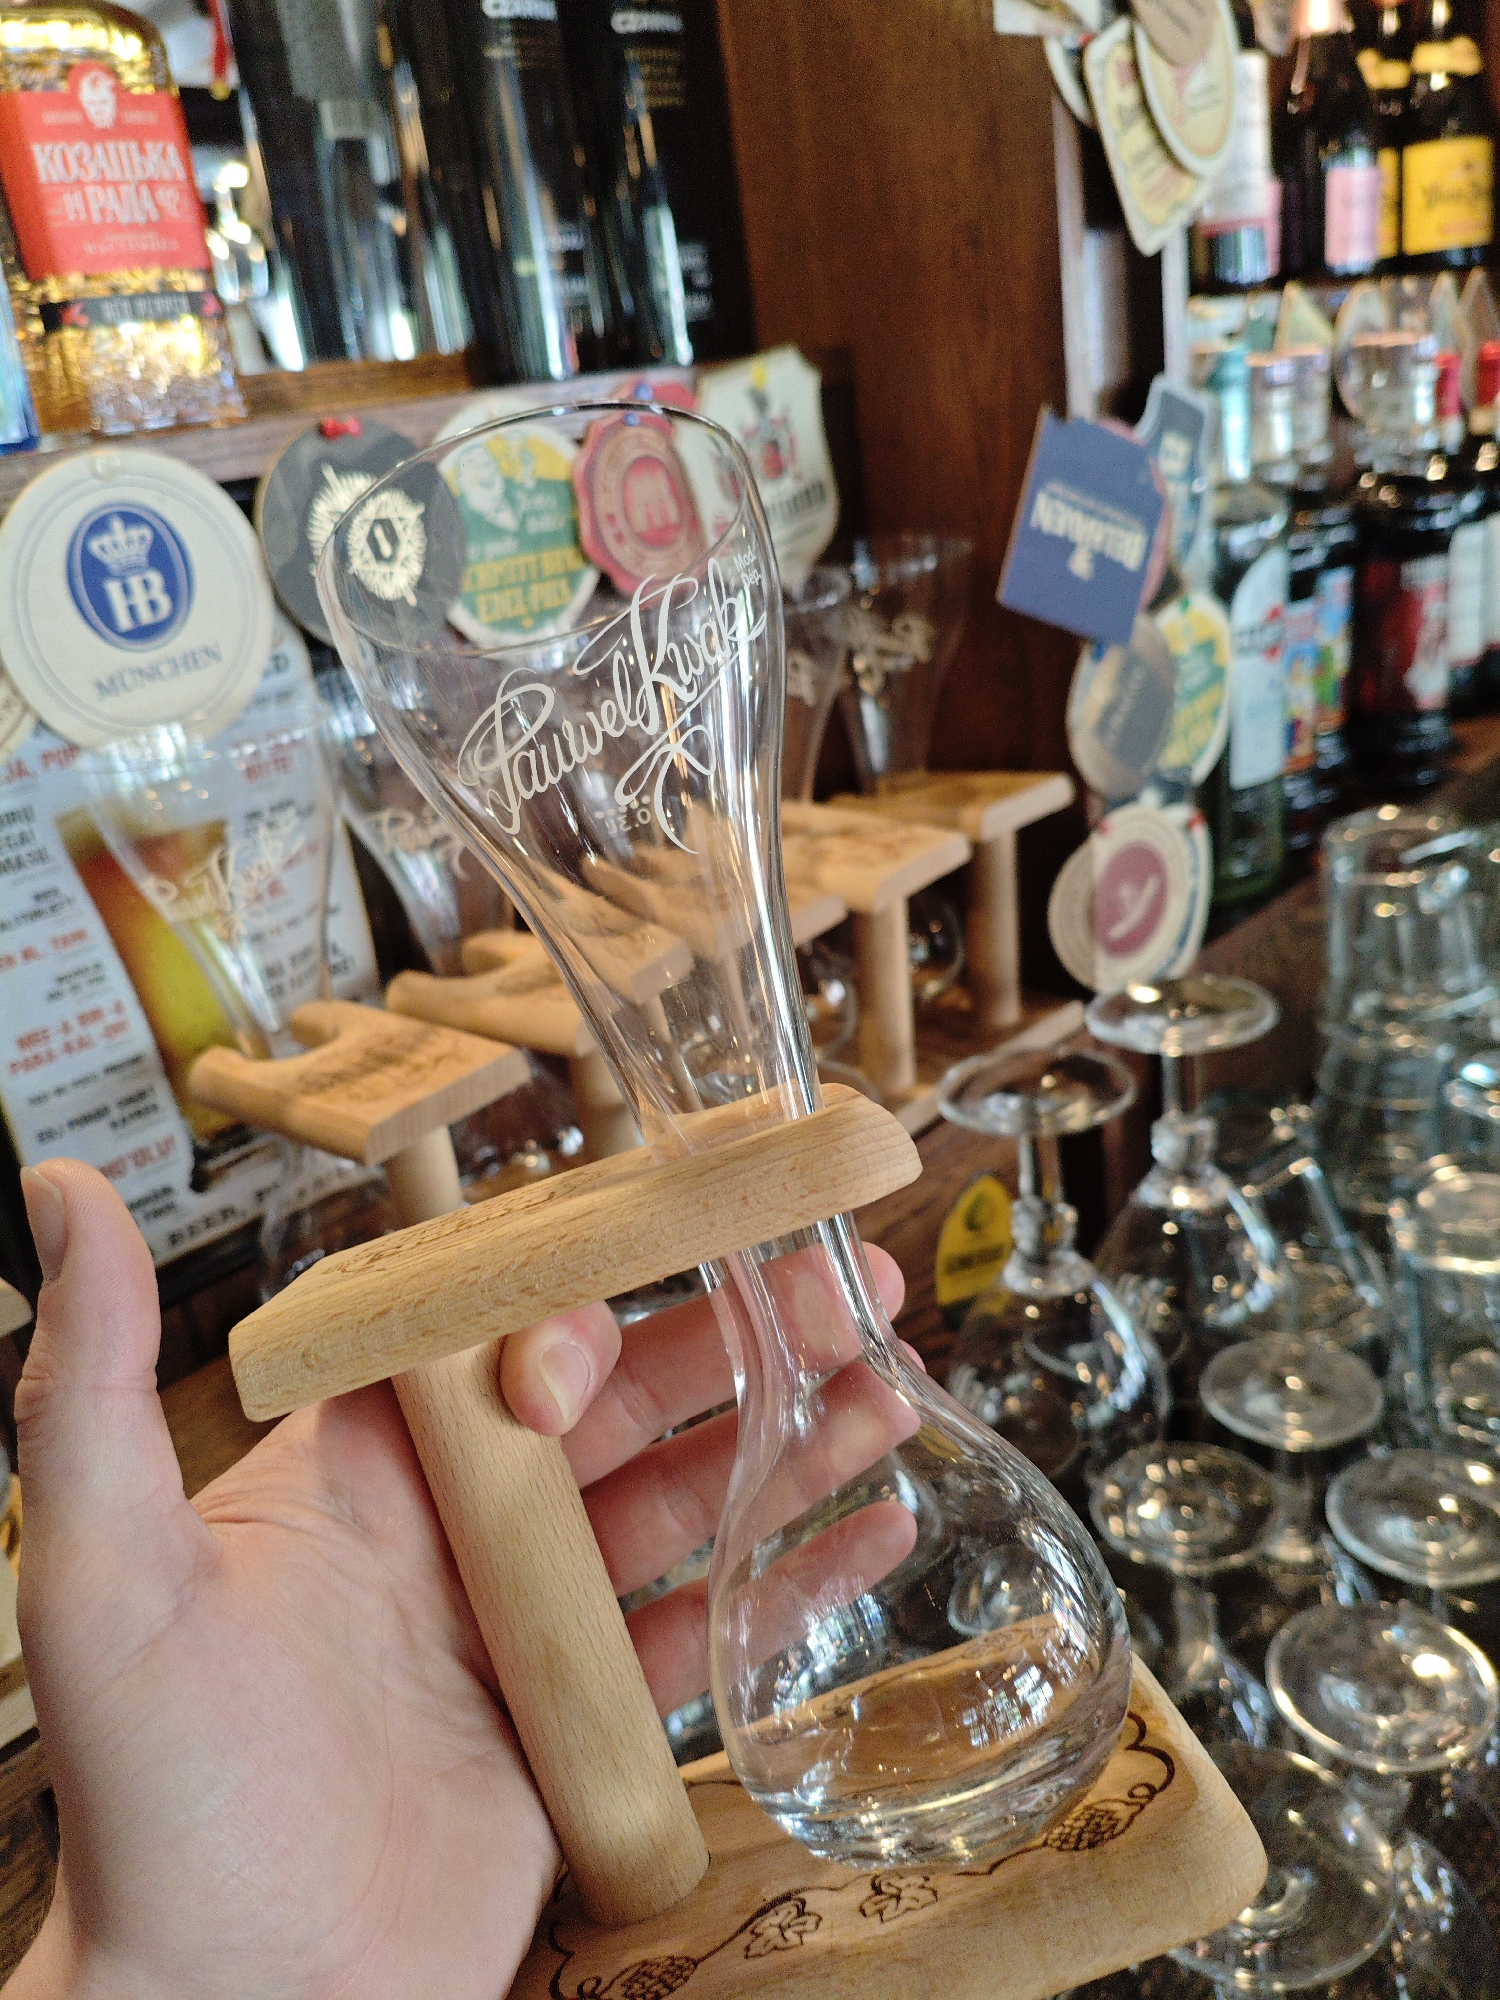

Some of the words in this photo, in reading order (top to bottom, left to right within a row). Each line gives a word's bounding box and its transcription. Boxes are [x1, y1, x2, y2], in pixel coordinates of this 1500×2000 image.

[733, 545, 757, 572] Mod.
[102, 565, 174, 633] HB
[91, 645, 223, 700] MÜNCHEN
[458, 651, 650, 834] Pauwel
[573, 558, 767, 735] Kwak
